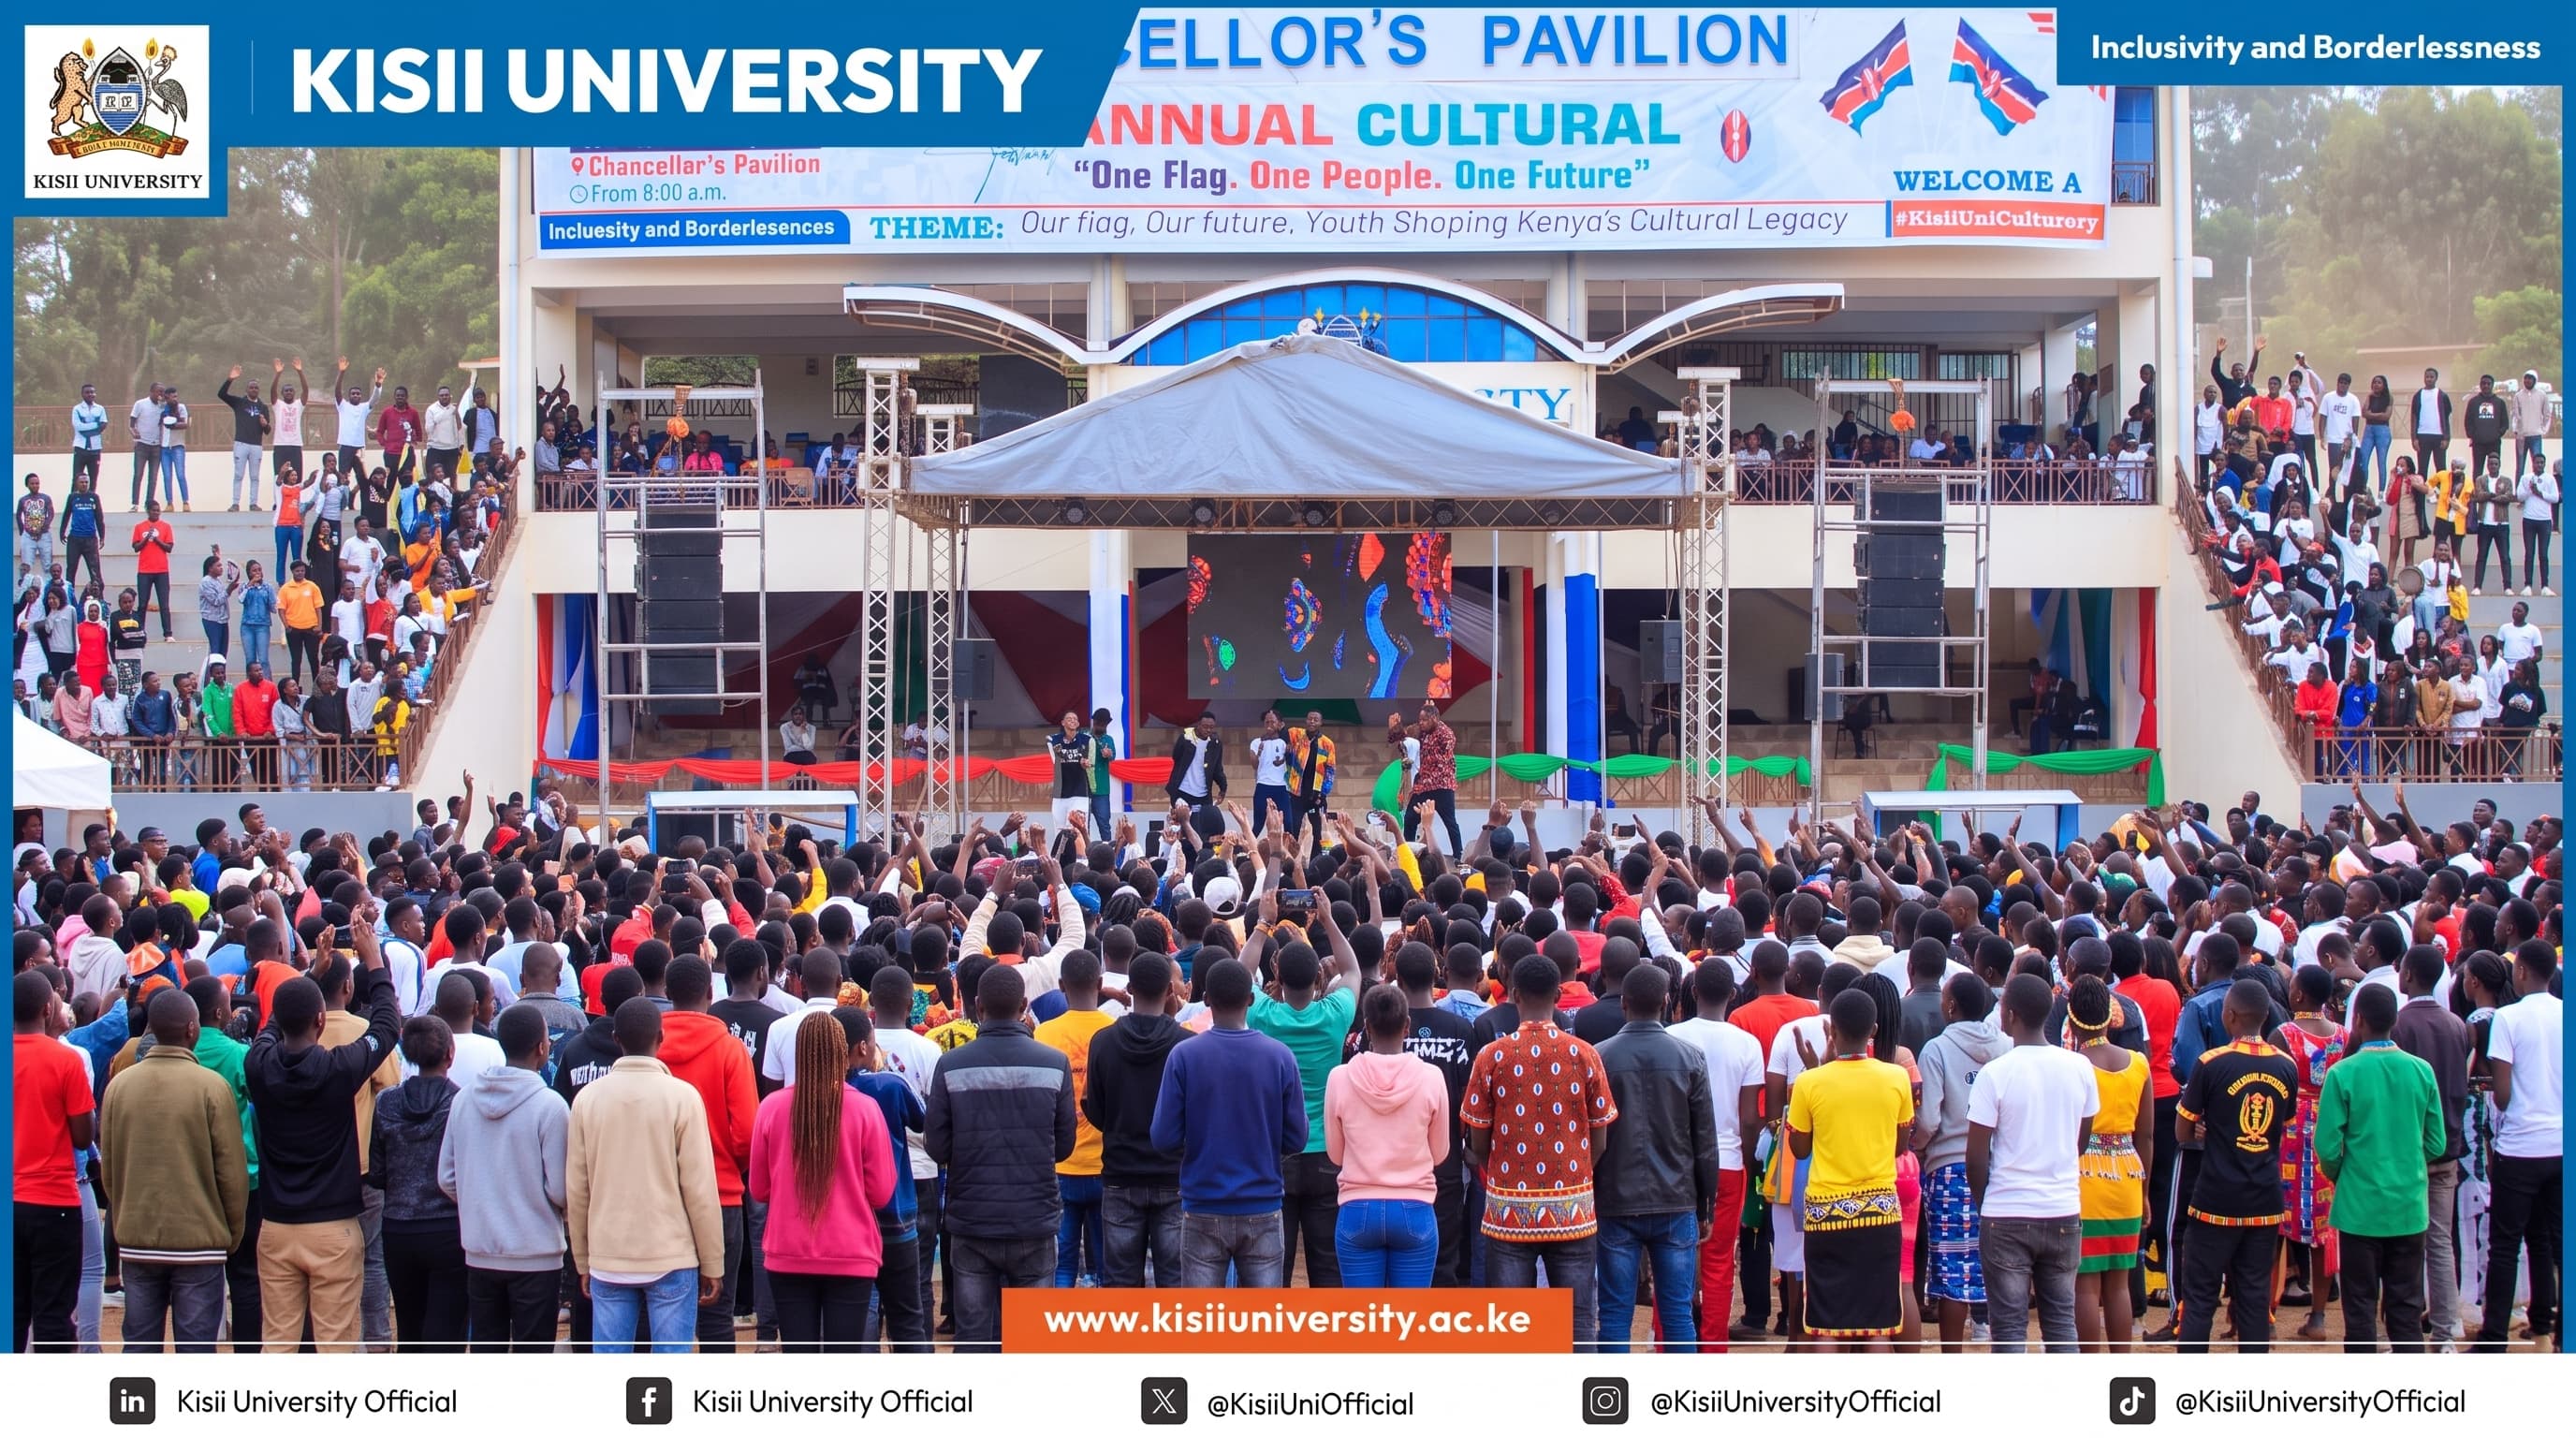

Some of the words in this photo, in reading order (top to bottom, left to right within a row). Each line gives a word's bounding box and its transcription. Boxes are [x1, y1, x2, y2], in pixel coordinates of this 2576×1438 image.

[1117, 8, 1427, 69] ELLOR'S
[1483, 14, 1788, 66] PAVILION
[1357, 103, 1681, 146] CULTURAL
[734, 153, 821, 175] Pavilion
[1164, 160, 1237, 196] Flag.
[1251, 160, 1310, 189] One
[1323, 160, 1442, 197] People.
[1456, 160, 1515, 189] One
[1894, 169, 2054, 193] WELCOME
[2062, 171, 2082, 193] A
[593, 184, 637, 203] From
[643, 183, 682, 202] 8:00
[688, 185, 726, 202] a.m.
[645, 220, 680, 238] and
[870, 216, 1003, 240] THEME:
[1022, 211, 1070, 233] Our
[1147, 210, 1199, 233] Our
[1203, 210, 1295, 236] future,
[1308, 210, 1383, 234] Youth
[1631, 208, 1738, 233] Cultural
[1748, 207, 1849, 236] Legacy
